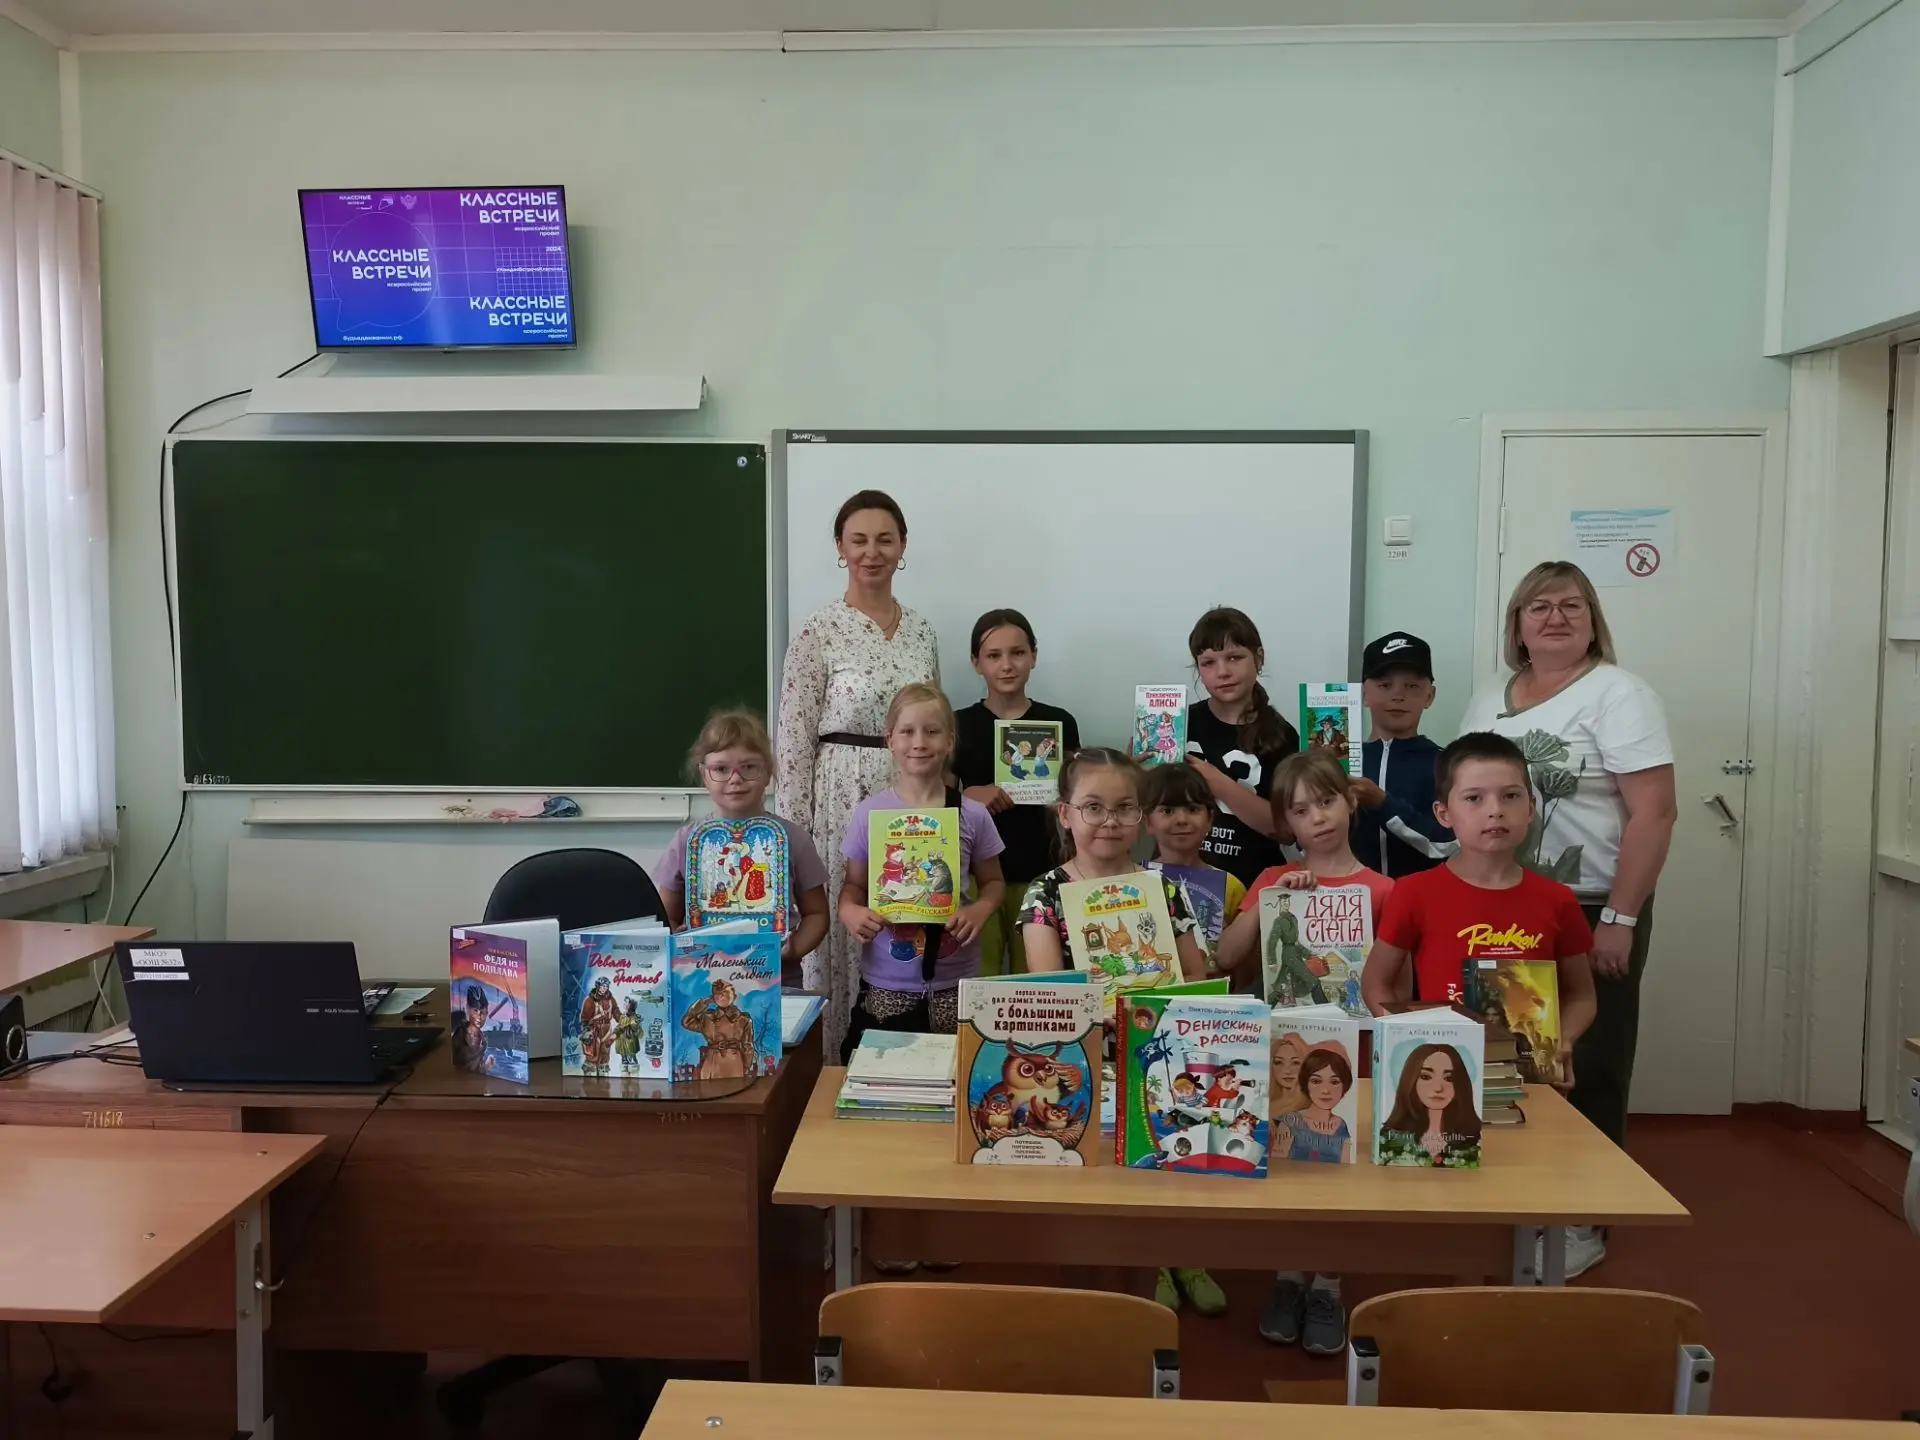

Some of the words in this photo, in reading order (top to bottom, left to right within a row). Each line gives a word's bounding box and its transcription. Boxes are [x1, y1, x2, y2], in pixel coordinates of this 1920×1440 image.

[460, 192, 557, 206] КЛАССНЫЕ
[480, 209, 559, 223] ВСТРЕЧИ
[333, 248, 430, 263] КЛАССНЫЕ
[352, 265, 431, 280] ВСТРЕЧИ
[469, 295, 566, 310] КЛАССНЫЕ
[489, 312, 568, 326] ВСТРЕЧИ
[1149, 699, 1178, 708] АЛИСЫ
[1211, 826, 1236, 841] BUT
[1214, 843, 1242, 857] QUIT
[1304, 894, 1364, 919] ДЯДЯ
[484, 953, 507, 967] ФЕДЯ
[588, 952, 632, 969] Девять
[696, 952, 769, 969] Маленький
[473, 962, 519, 979] ПОДПЛАВА
[613, 968, 663, 987] братьев
[729, 967, 774, 981] солдат
[991, 997, 1006, 1005] для
[1008, 1004, 1073, 1020] большими
[1188, 1006, 1213, 1014] Виктор
[1214, 1008, 1253, 1016] Драгунский
[994, 1020, 1076, 1033] картинками
[1176, 1020, 1262, 1036] ДЕНИСКИНЫ
[1200, 1034, 1260, 1048] РАССКАЗЫ
